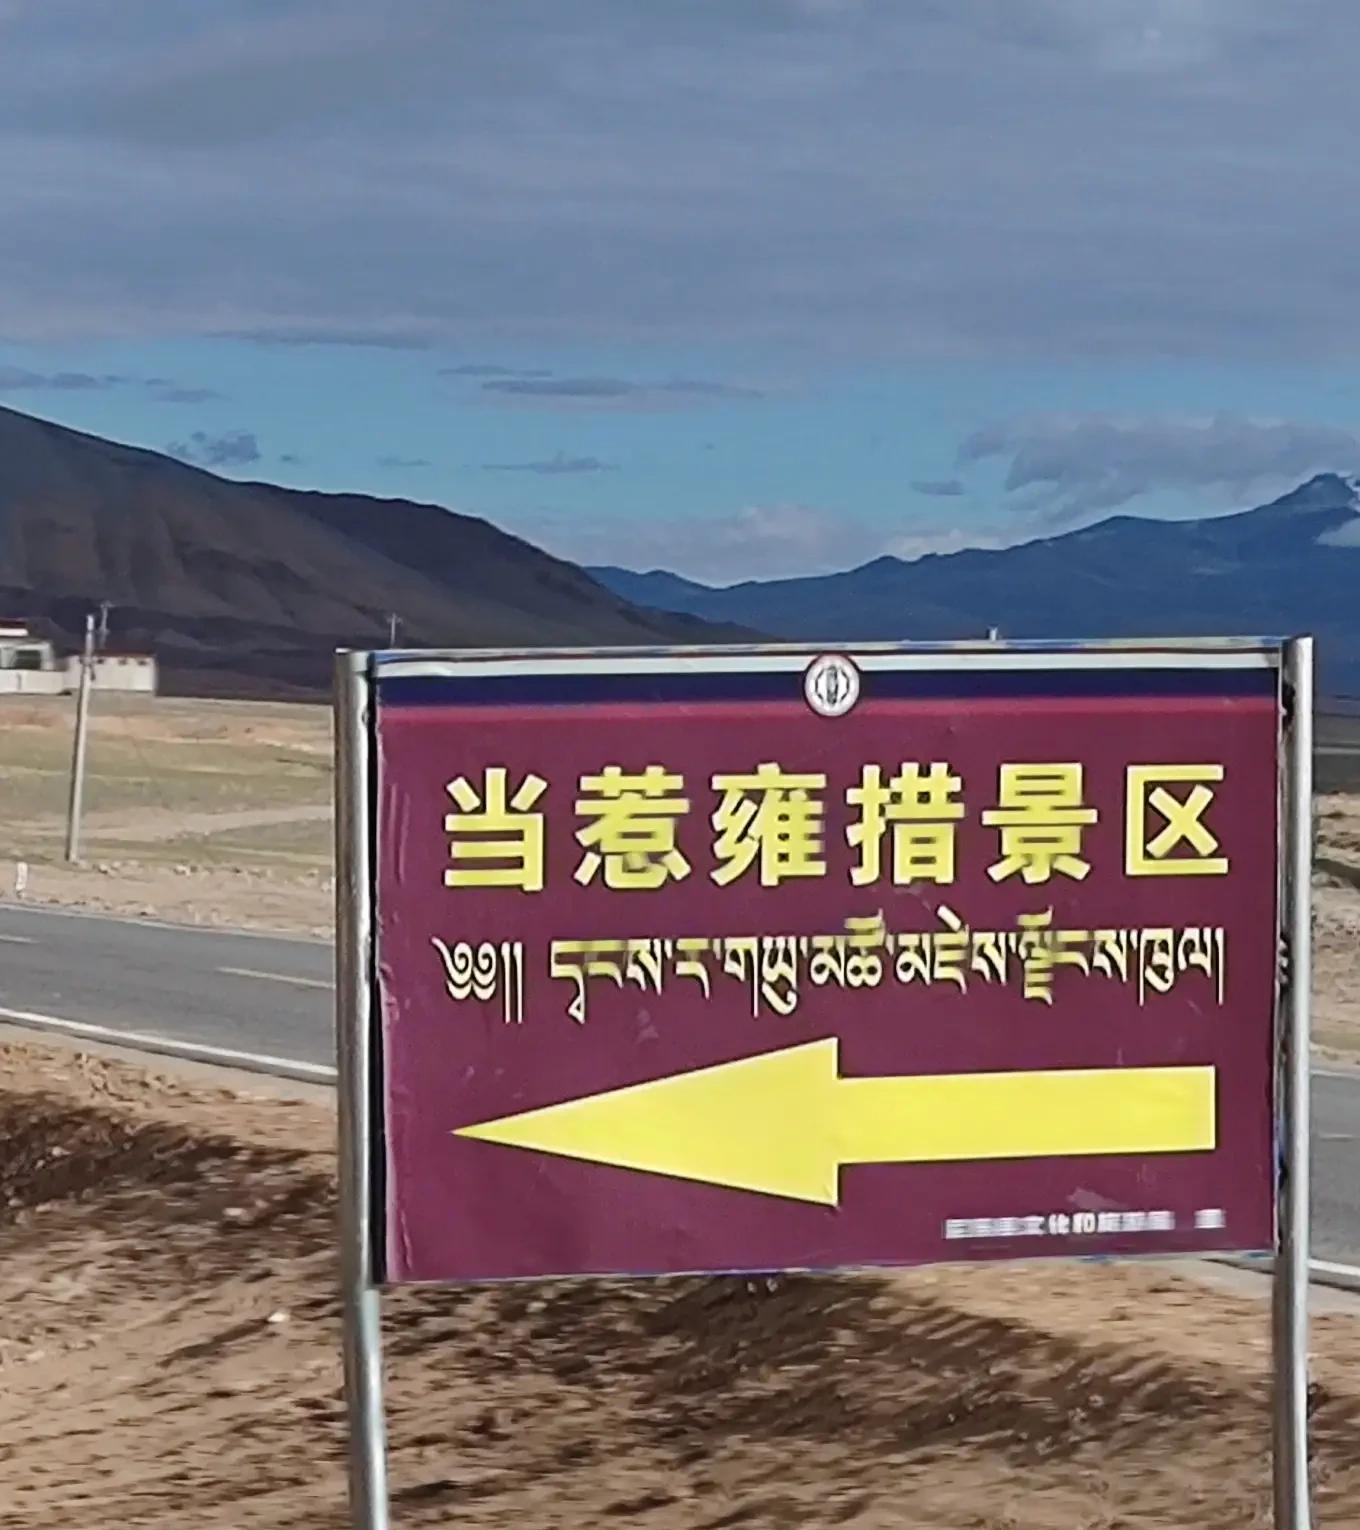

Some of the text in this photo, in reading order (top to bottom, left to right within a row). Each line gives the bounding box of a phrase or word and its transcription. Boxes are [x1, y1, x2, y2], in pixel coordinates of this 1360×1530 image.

[444, 763, 1229, 892] 当惹雍措景区
